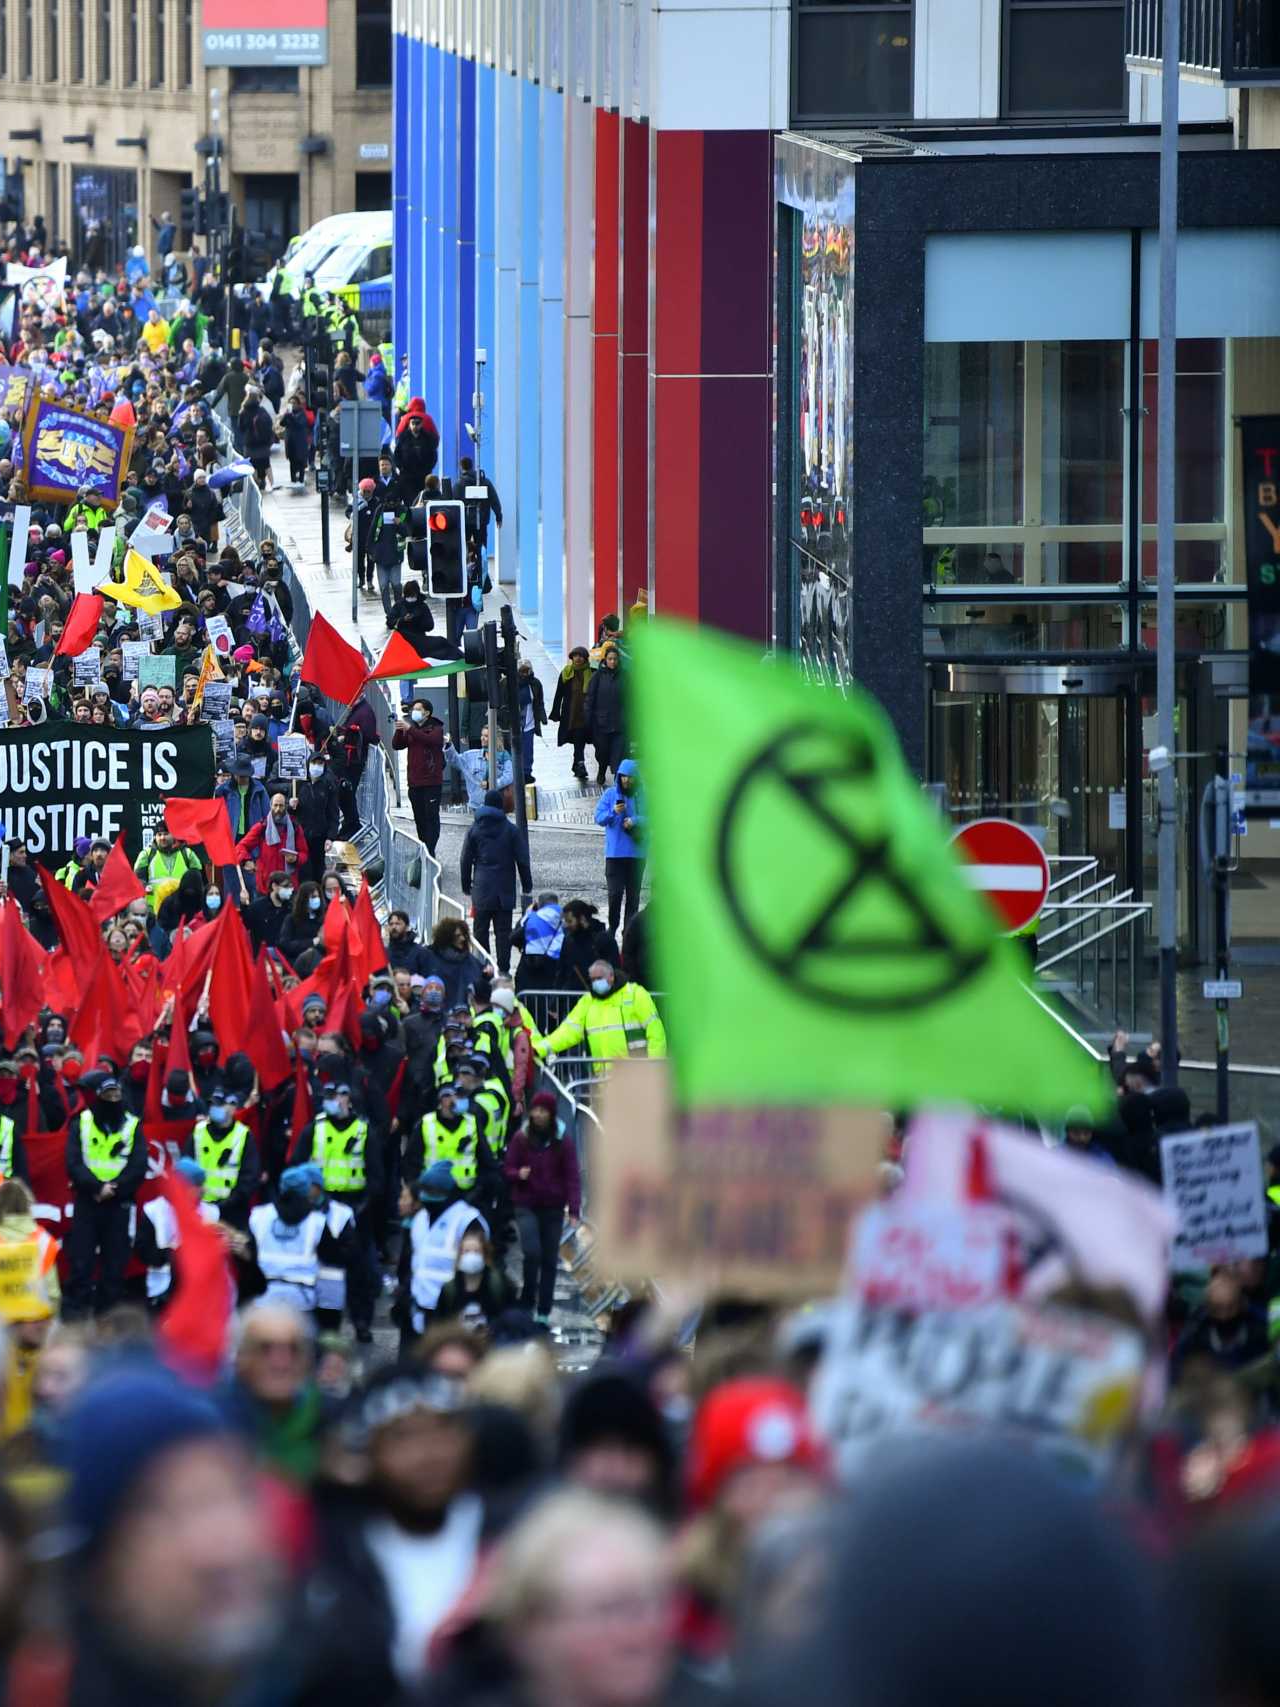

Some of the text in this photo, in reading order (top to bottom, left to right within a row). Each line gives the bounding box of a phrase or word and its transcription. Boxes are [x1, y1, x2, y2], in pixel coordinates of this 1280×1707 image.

[206, 33, 320, 49] 0141 304 3232
[142, 741, 178, 791] IS
[140, 803, 166, 814] LIVI
[141, 815, 165, 827] REN
